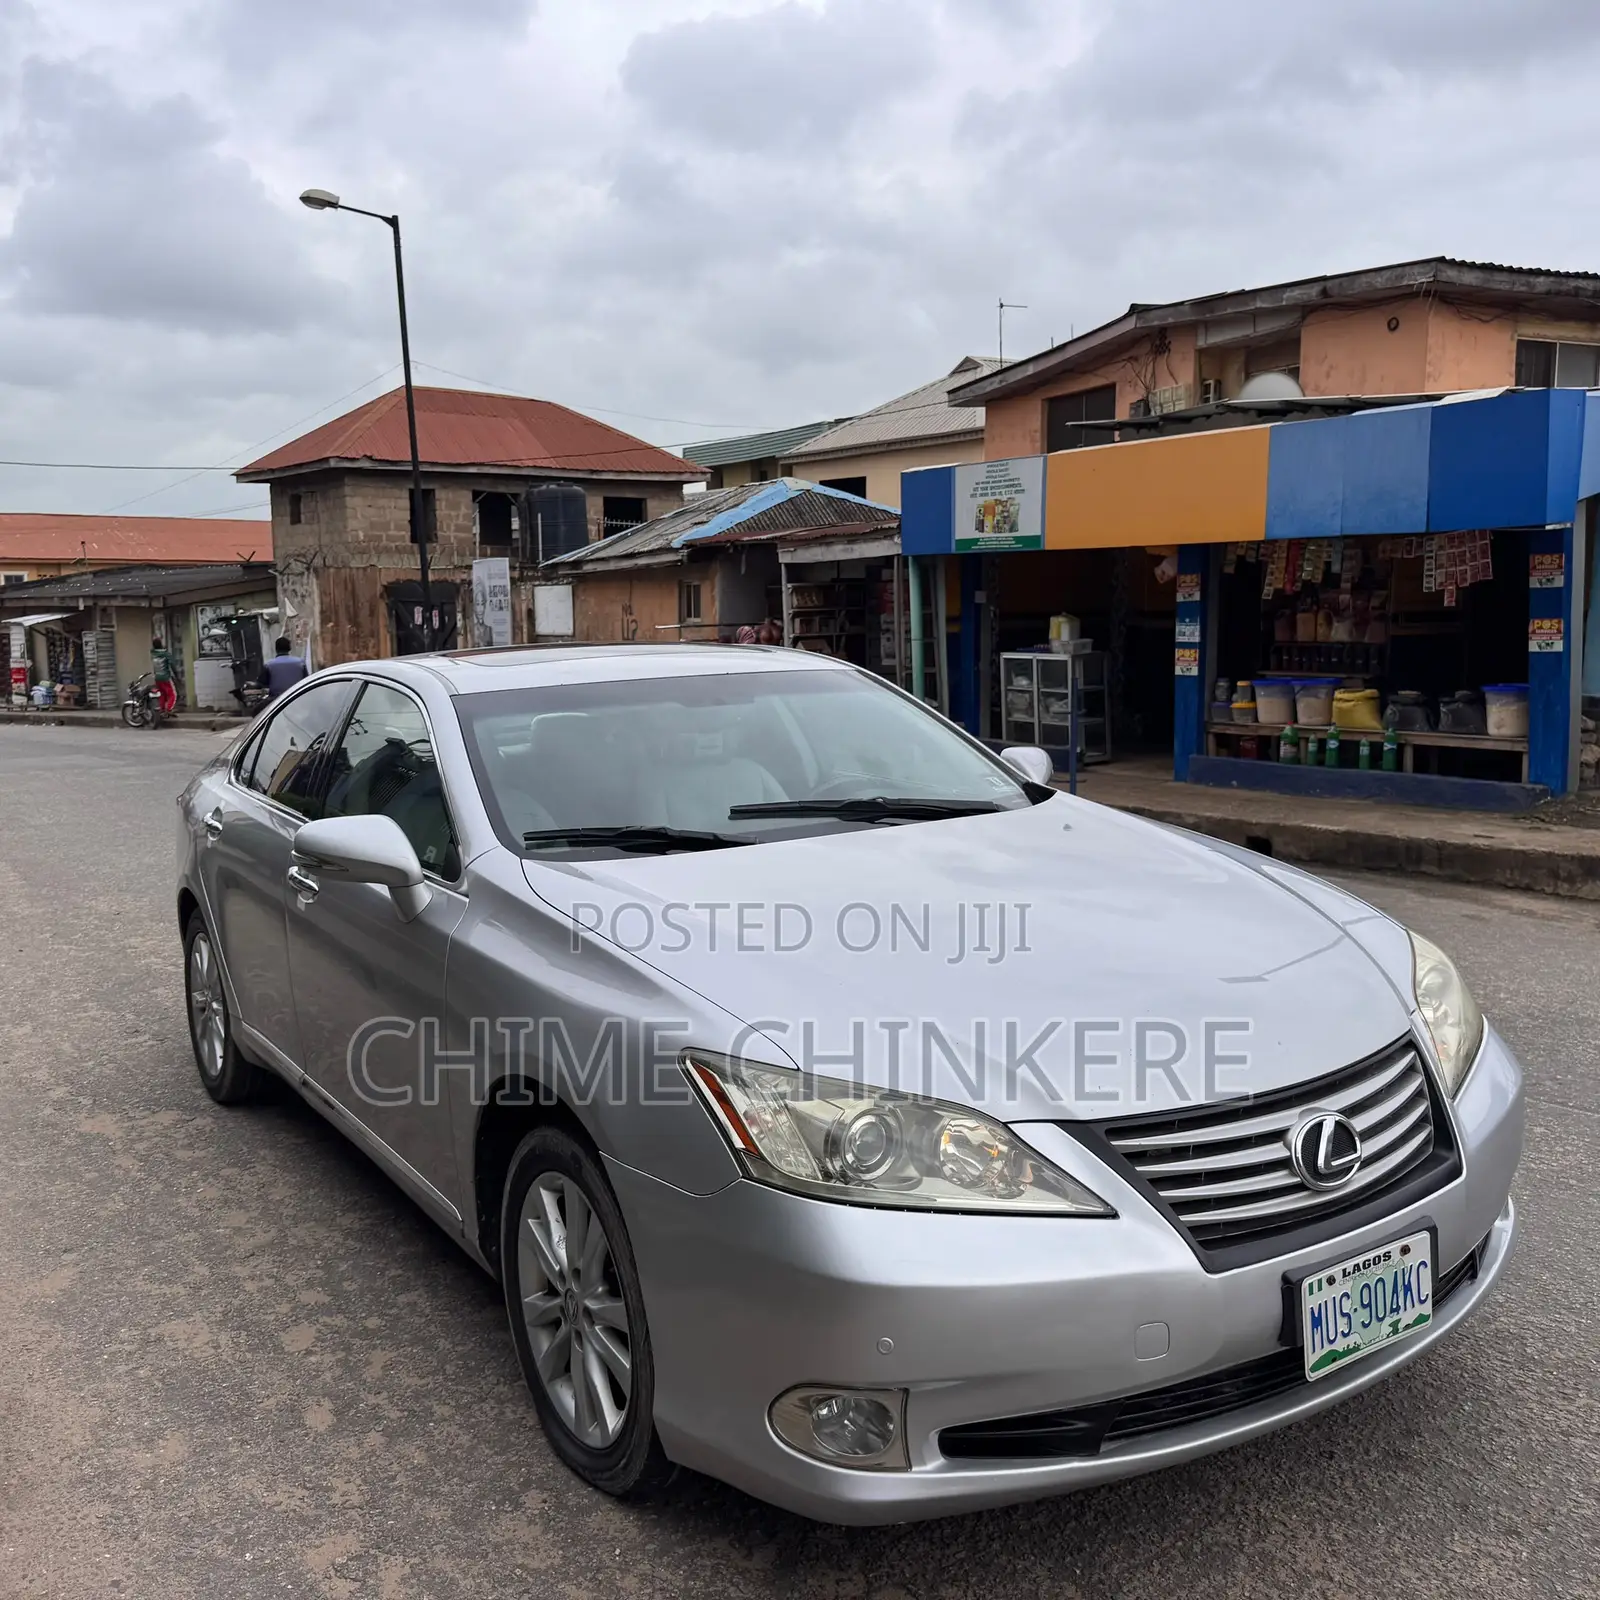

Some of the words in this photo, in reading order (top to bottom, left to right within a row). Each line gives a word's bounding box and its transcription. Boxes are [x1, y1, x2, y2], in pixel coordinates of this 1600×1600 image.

[1534, 554, 1560, 565] POS
[1534, 620, 1559, 630] POS
[1341, 1251, 1392, 1279] LAGOS
